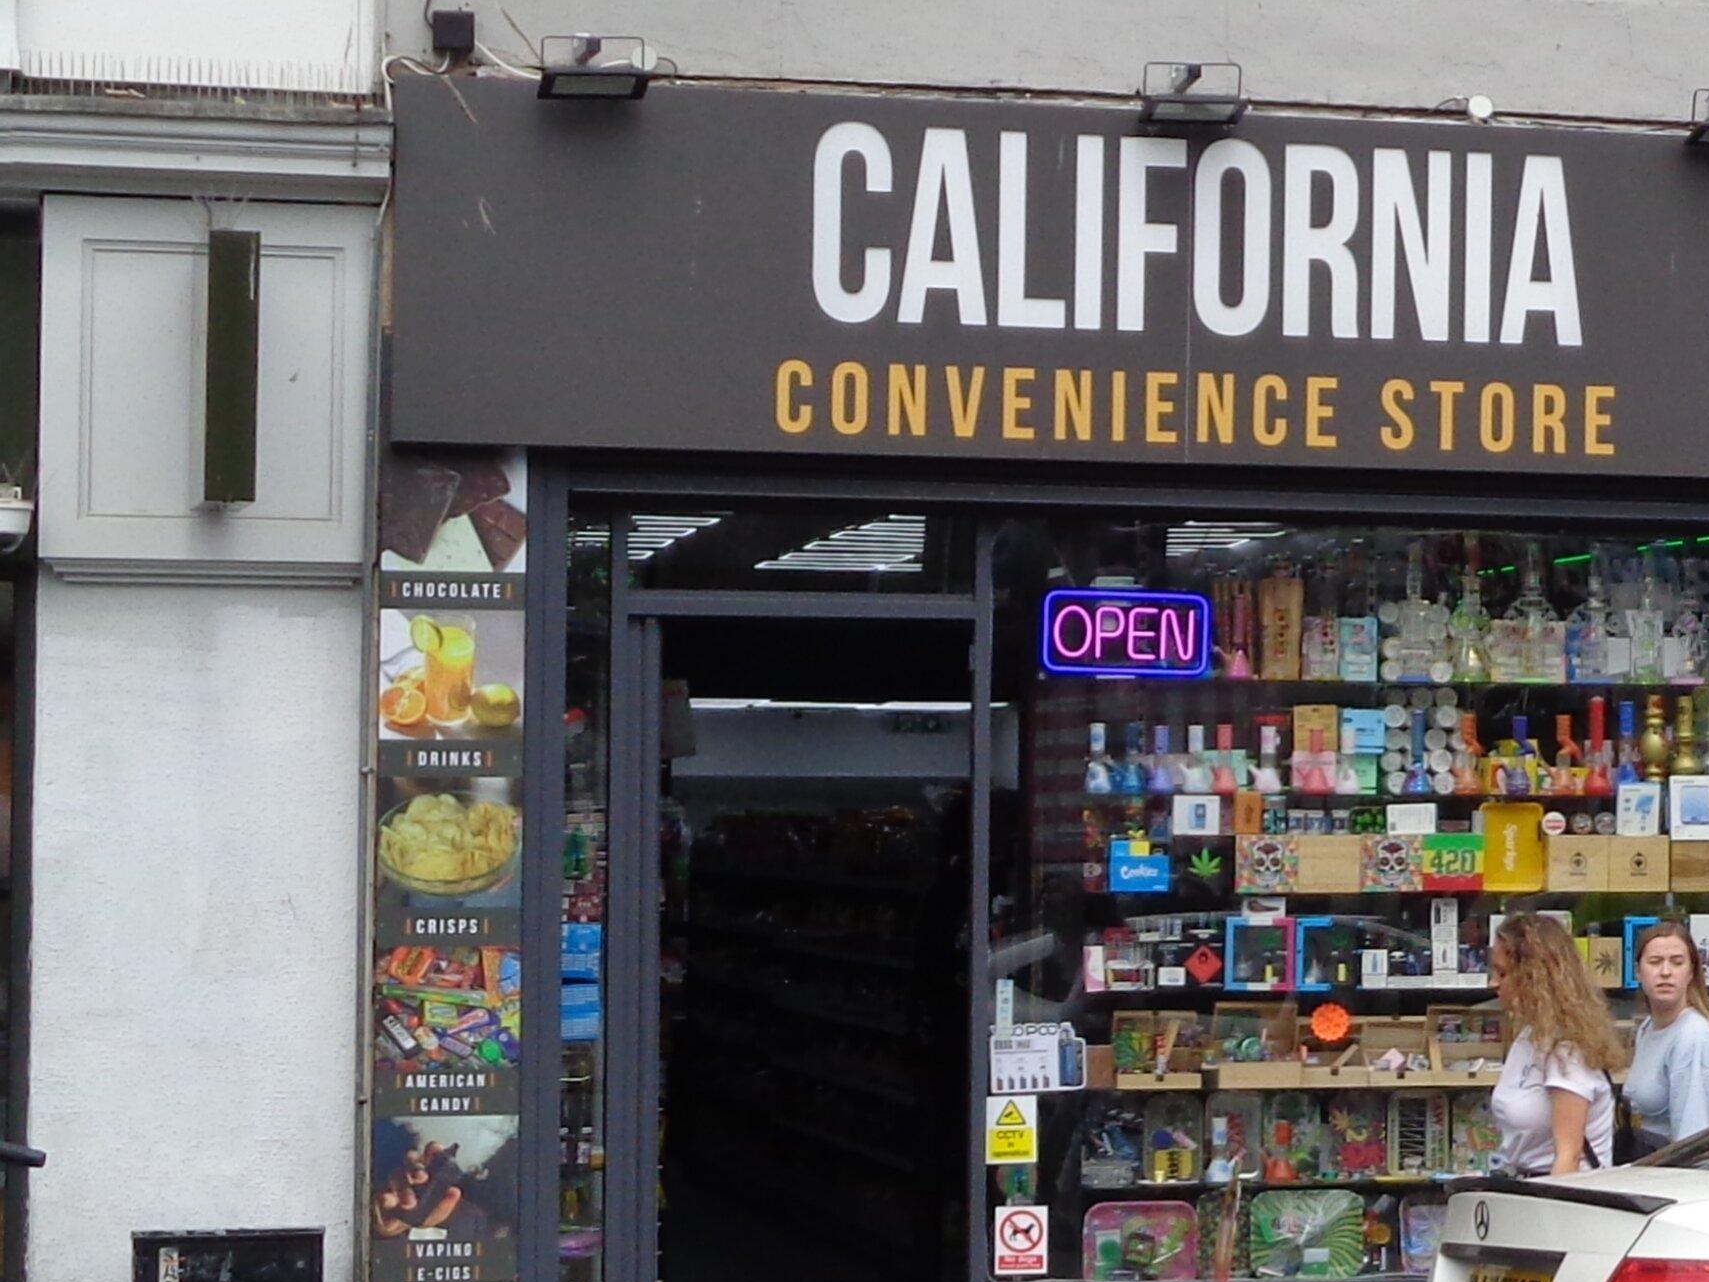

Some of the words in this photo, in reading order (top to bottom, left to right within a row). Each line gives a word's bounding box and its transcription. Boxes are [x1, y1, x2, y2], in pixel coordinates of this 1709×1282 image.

[810, 122, 1583, 348] CALIFORNIA
[775, 358, 1341, 451] CONVENIENCE
[1379, 378, 1619, 458] STORE
[401, 581, 502, 599] CHOCOLATE
[1053, 604, 1195, 661] OPEN
[417, 750, 482, 767] DRINKS
[1429, 847, 1476, 876] 420
[415, 918, 479, 935] CRISPS
[405, 1073, 487, 1088] AMERICAN
[420, 1096, 472, 1112] CANDY
[996, 1130, 1025, 1140] CCTV
[415, 1242, 473, 1258] VAPING
[416, 1265, 472, 1281] E-CIGS
